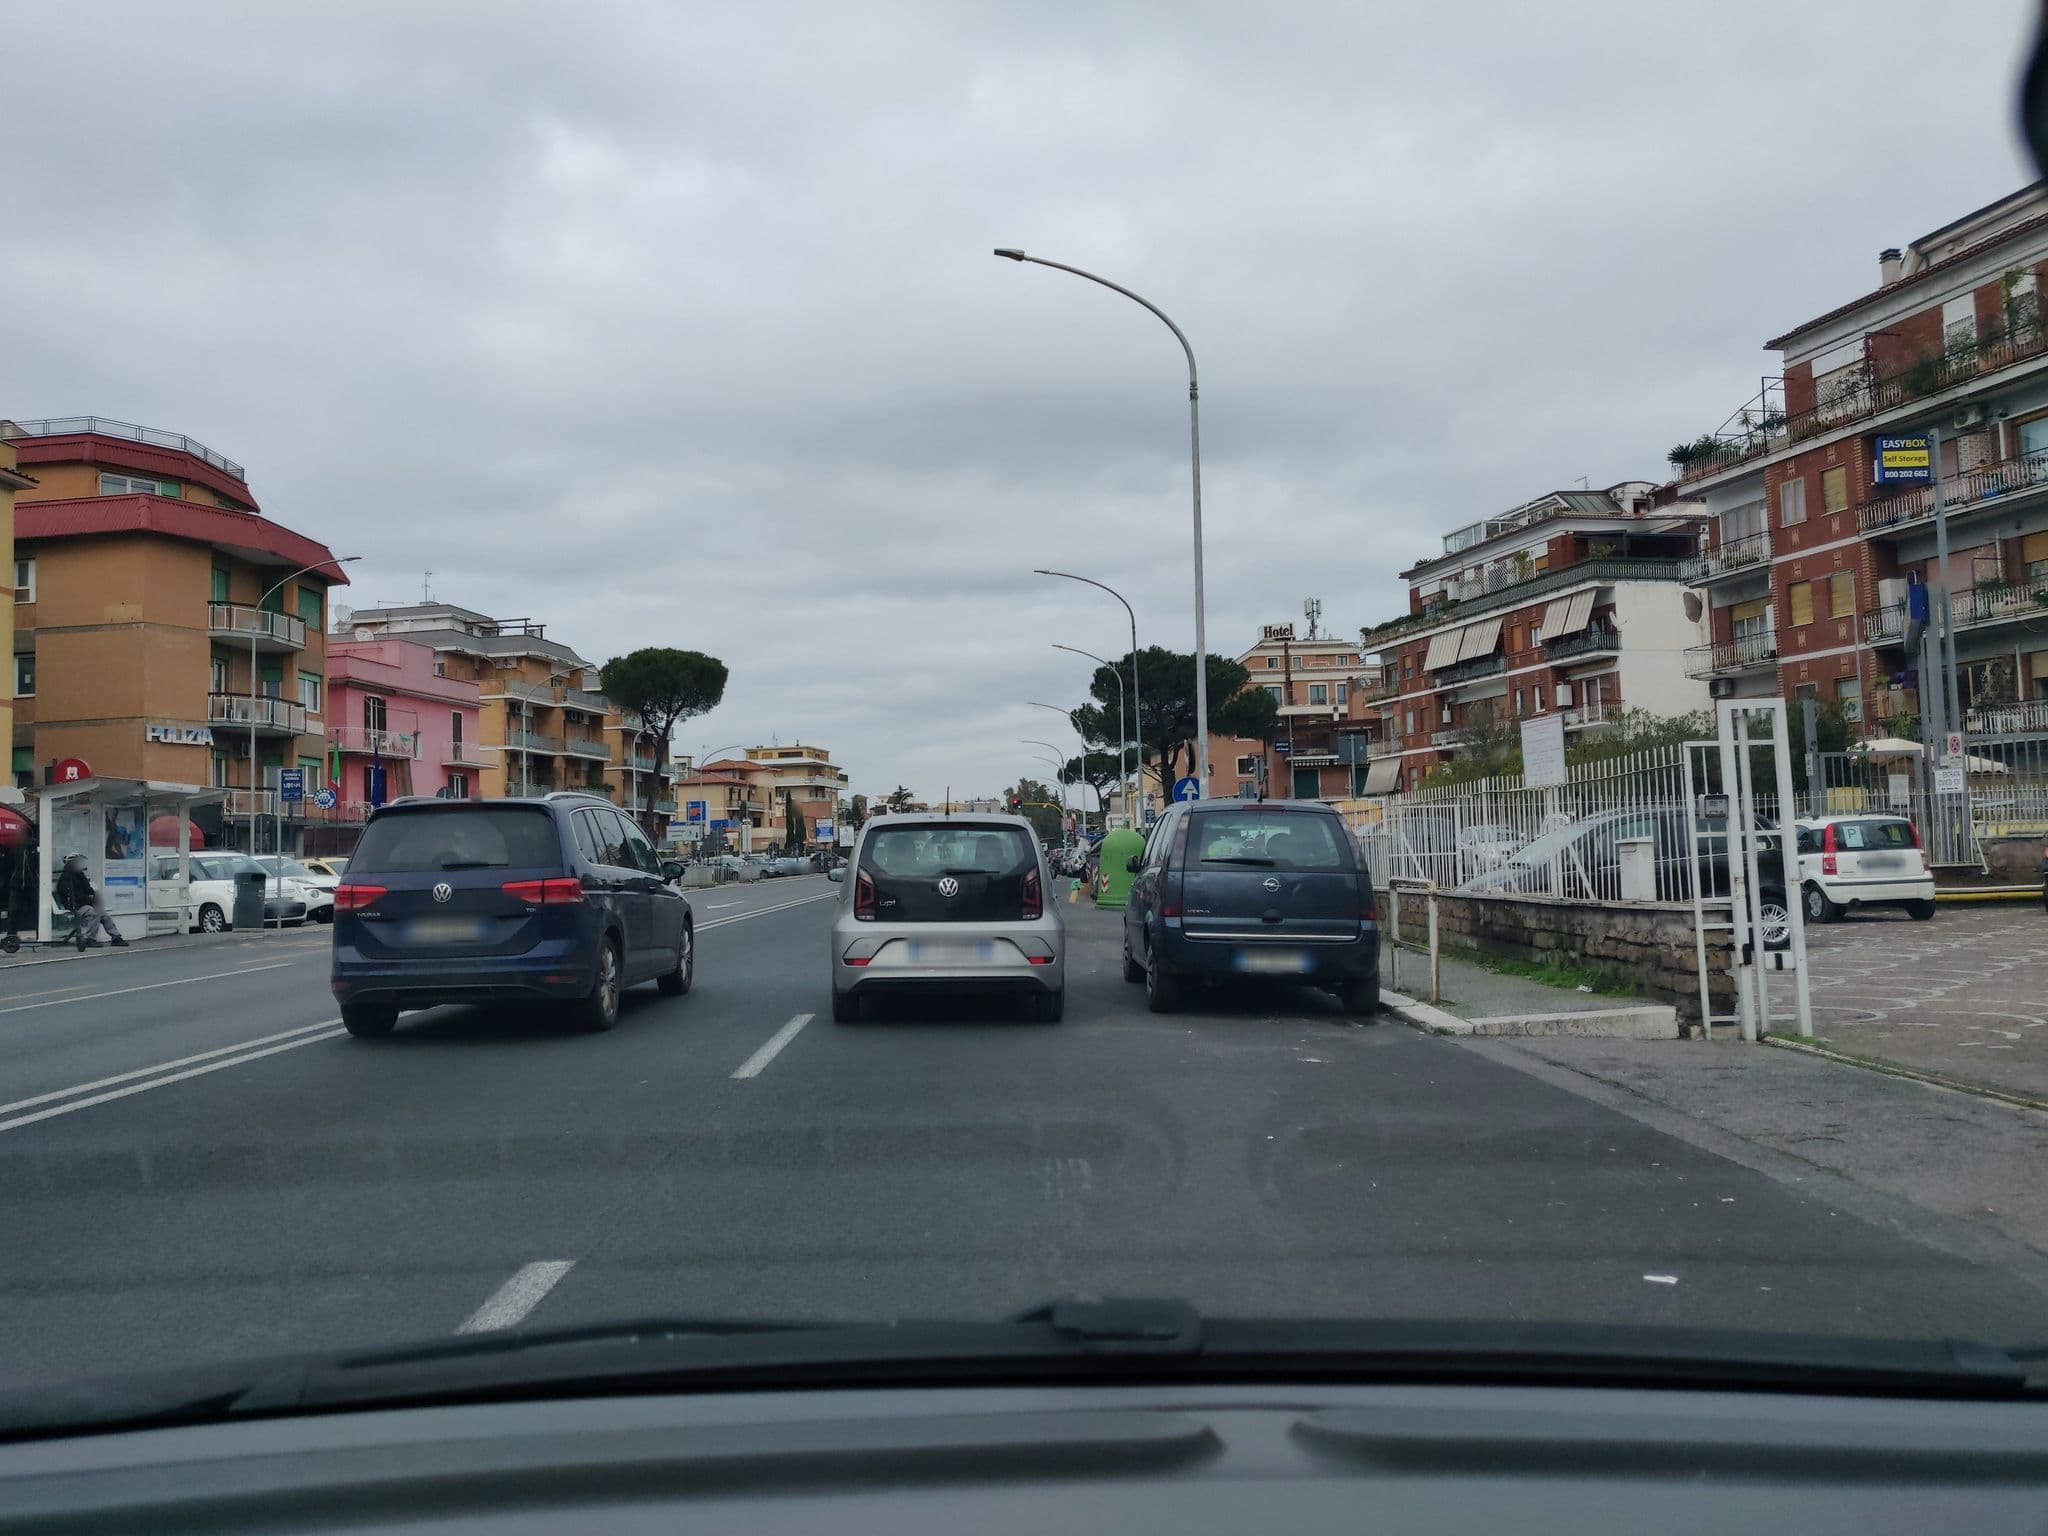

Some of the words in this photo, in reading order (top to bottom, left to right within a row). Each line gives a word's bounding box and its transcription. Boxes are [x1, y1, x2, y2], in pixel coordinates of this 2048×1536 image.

[1882, 439, 1926, 449] EASYBOX
[1899, 455, 1927, 463] Storage
[1884, 470, 1899, 478] 800
[1899, 470, 1913, 478] 202
[1263, 623, 1293, 638] Hotel
[145, 725, 214, 746] POLIZIA
[1847, 828, 1857, 840] P
